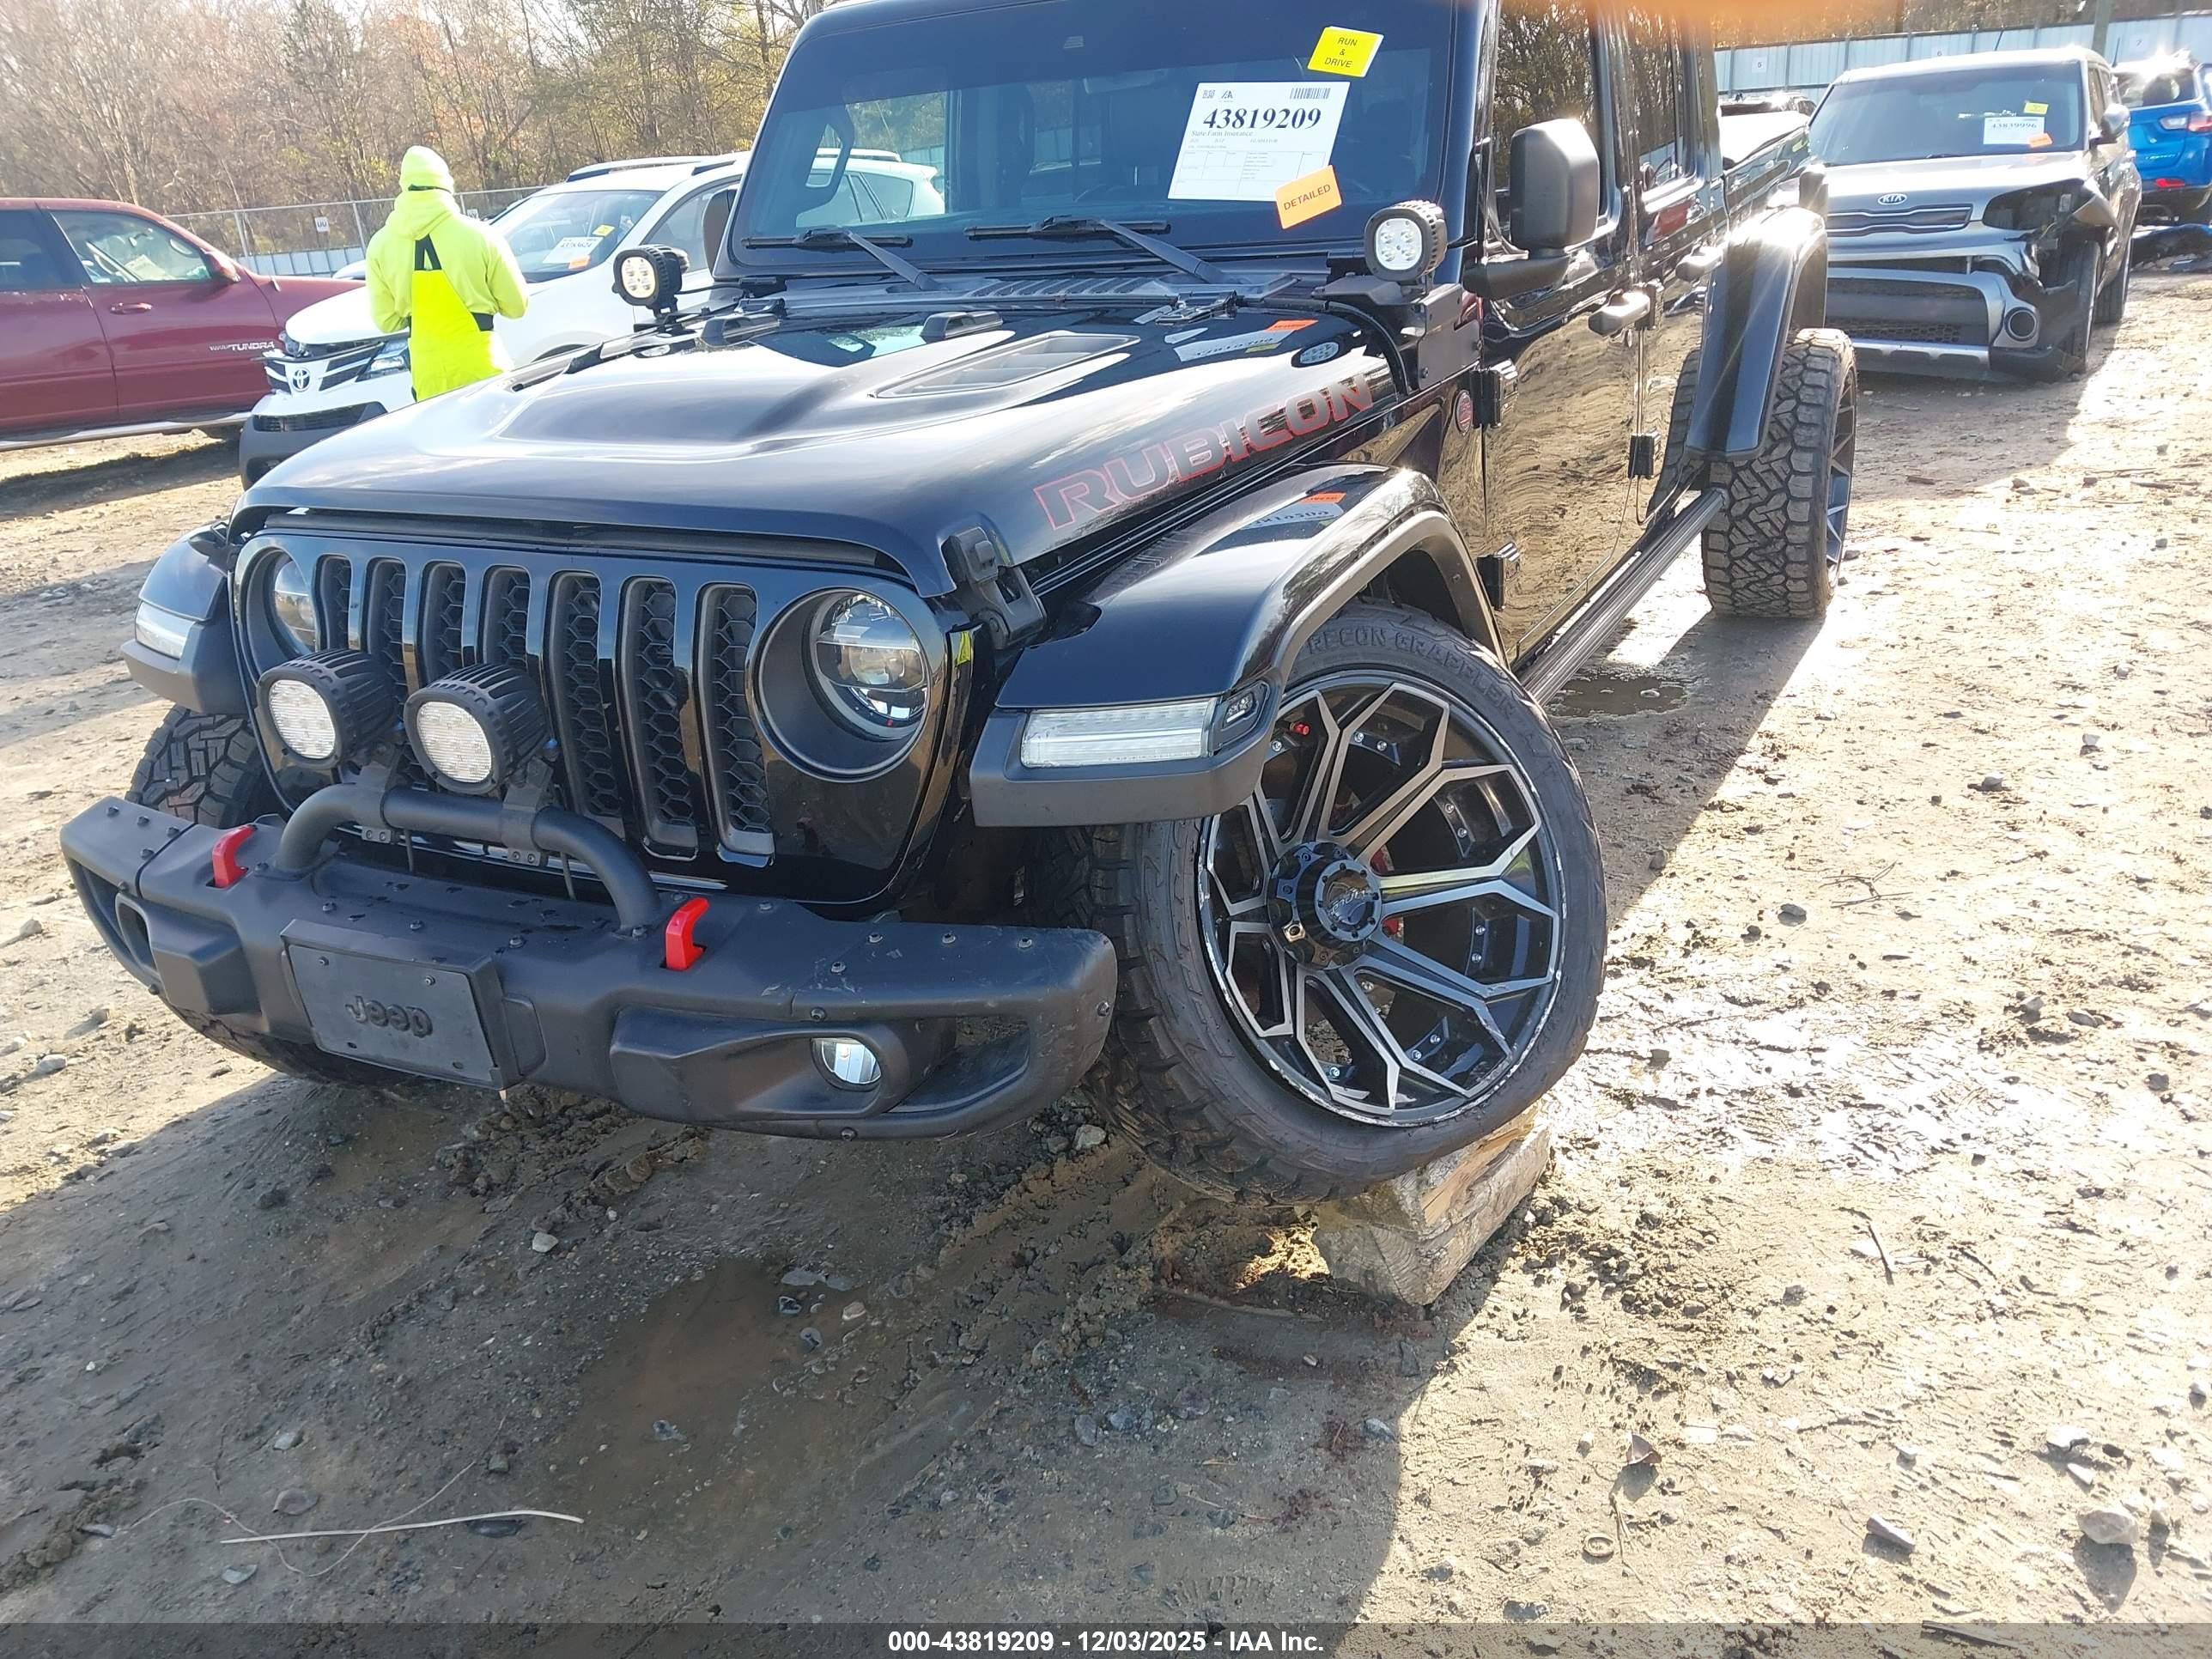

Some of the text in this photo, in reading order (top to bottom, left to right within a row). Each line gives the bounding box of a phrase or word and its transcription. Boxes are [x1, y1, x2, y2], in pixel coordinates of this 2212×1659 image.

[1337, 37, 1358, 46] RUN
[1324, 57, 1352, 68] DRIVE
[1202, 107, 1322, 130] 43819209
[1283, 184, 1331, 210] DETAILED
[1881, 194, 1904, 204] KIA
[231, 341, 275, 350] TUNDRA
[1033, 374, 1374, 531] RUBICON
[1306, 626, 1518, 718] RECON GRAPPLER
[345, 995, 434, 1038] Jeep
